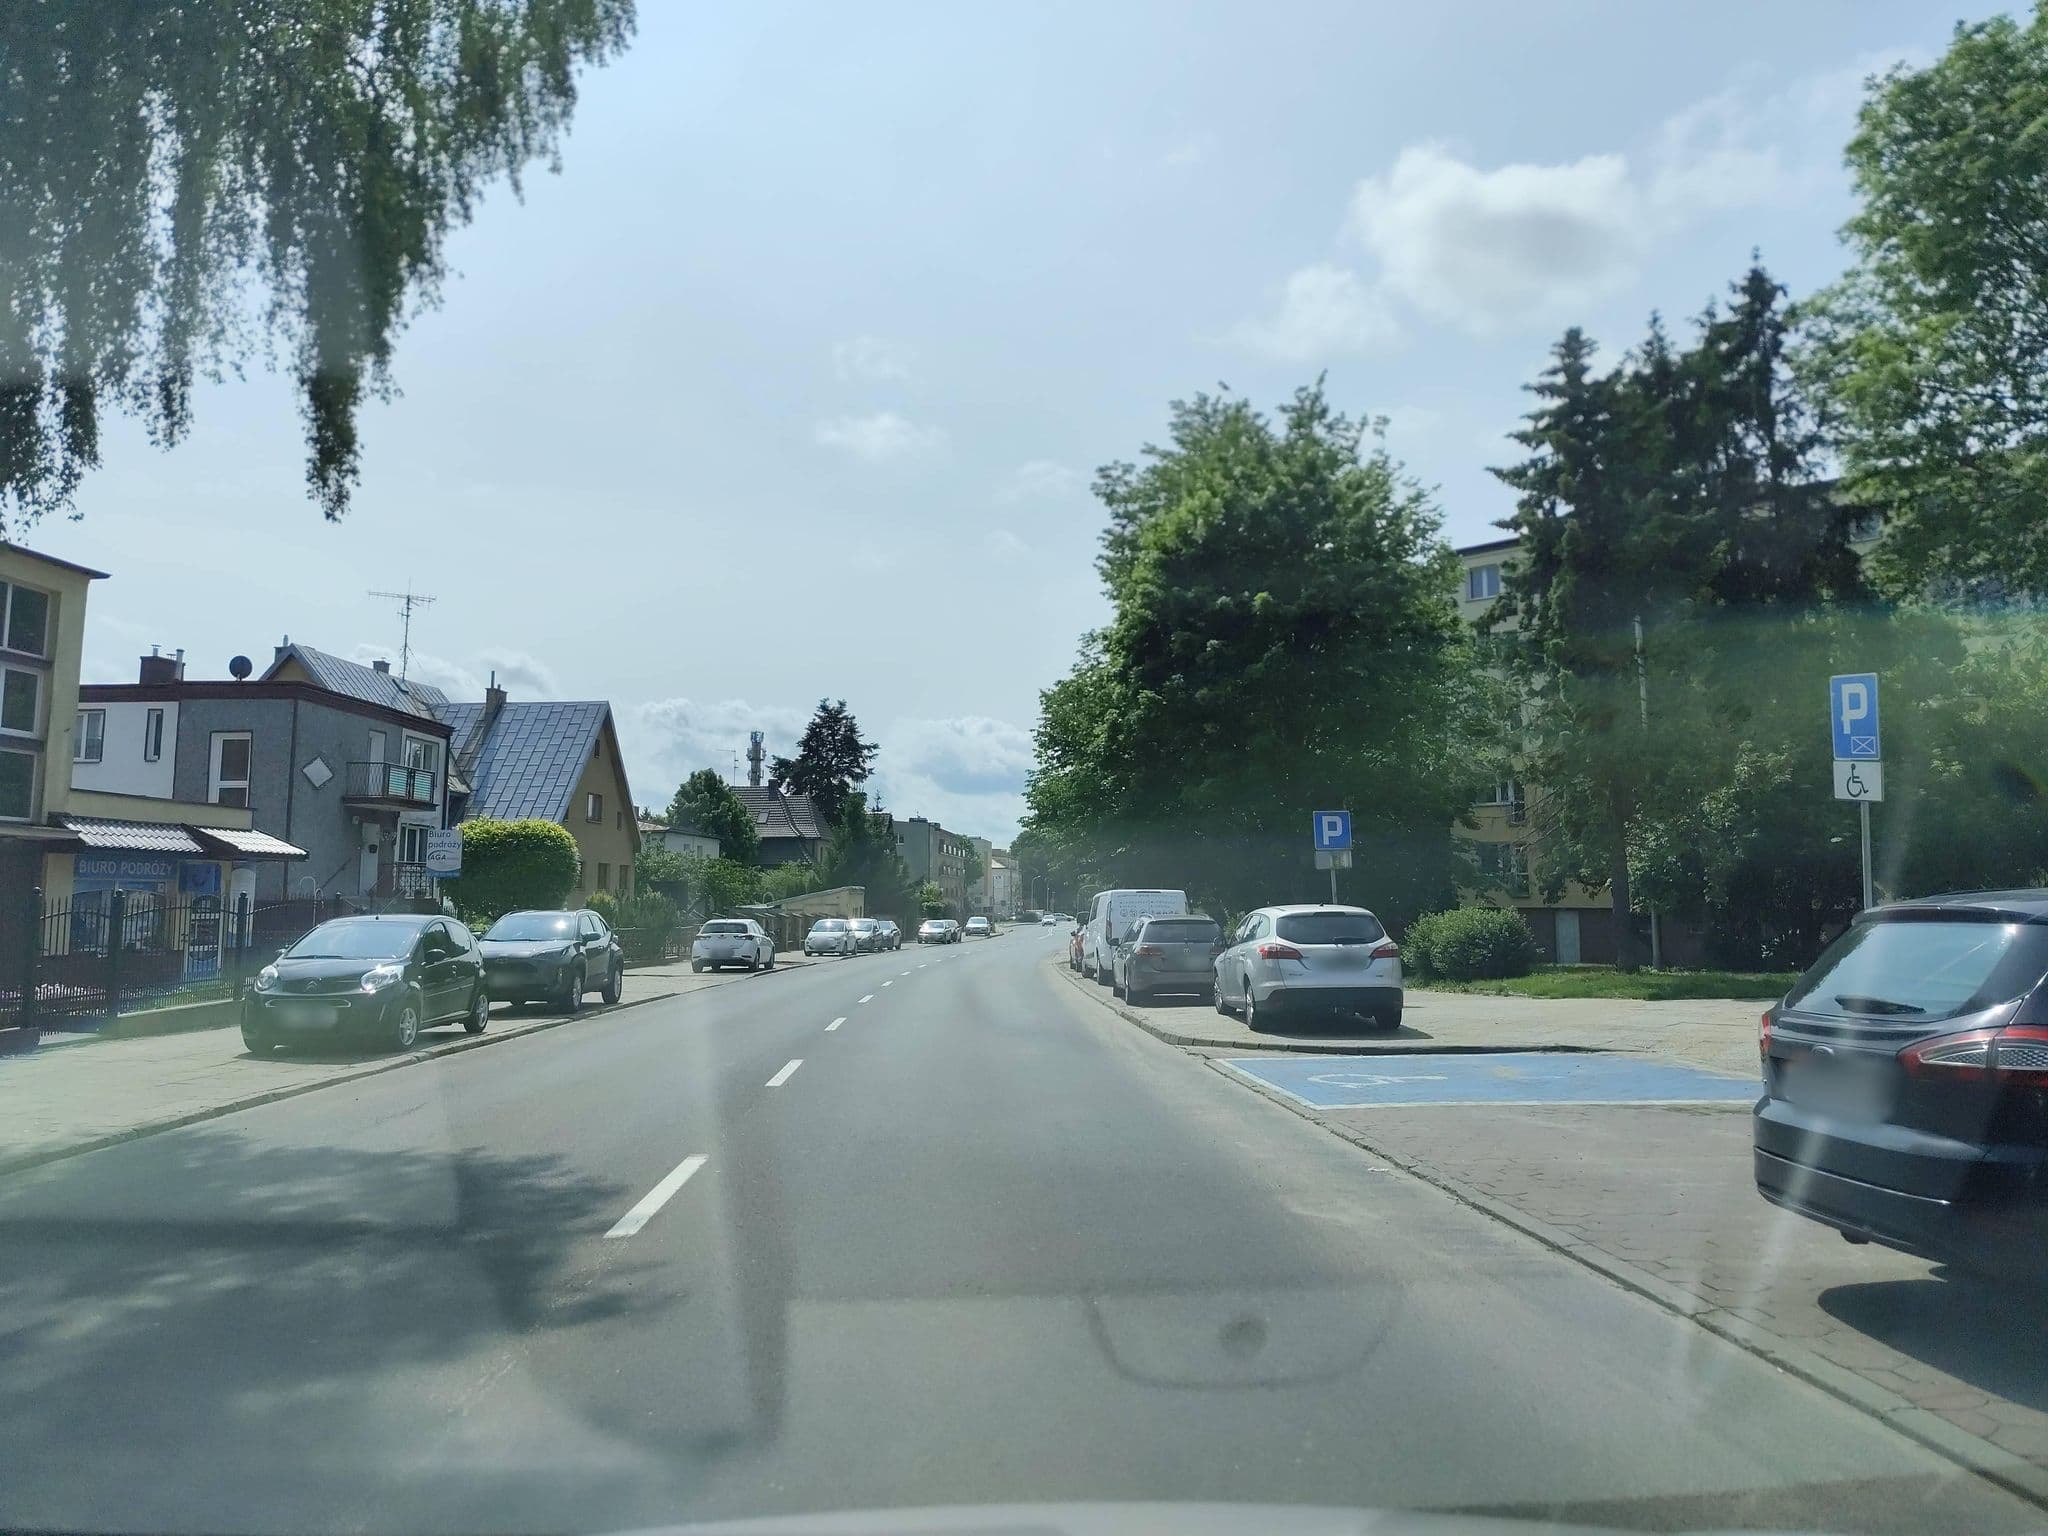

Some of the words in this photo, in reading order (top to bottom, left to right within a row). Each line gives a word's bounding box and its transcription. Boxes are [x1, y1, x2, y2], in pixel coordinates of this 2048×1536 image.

[1841, 683, 1868, 734] P
[429, 831, 451, 839] Biuro
[1322, 816, 1342, 845] P
[79, 860, 116, 874] BIURO
[120, 860, 174, 876] PODRÓŻY
